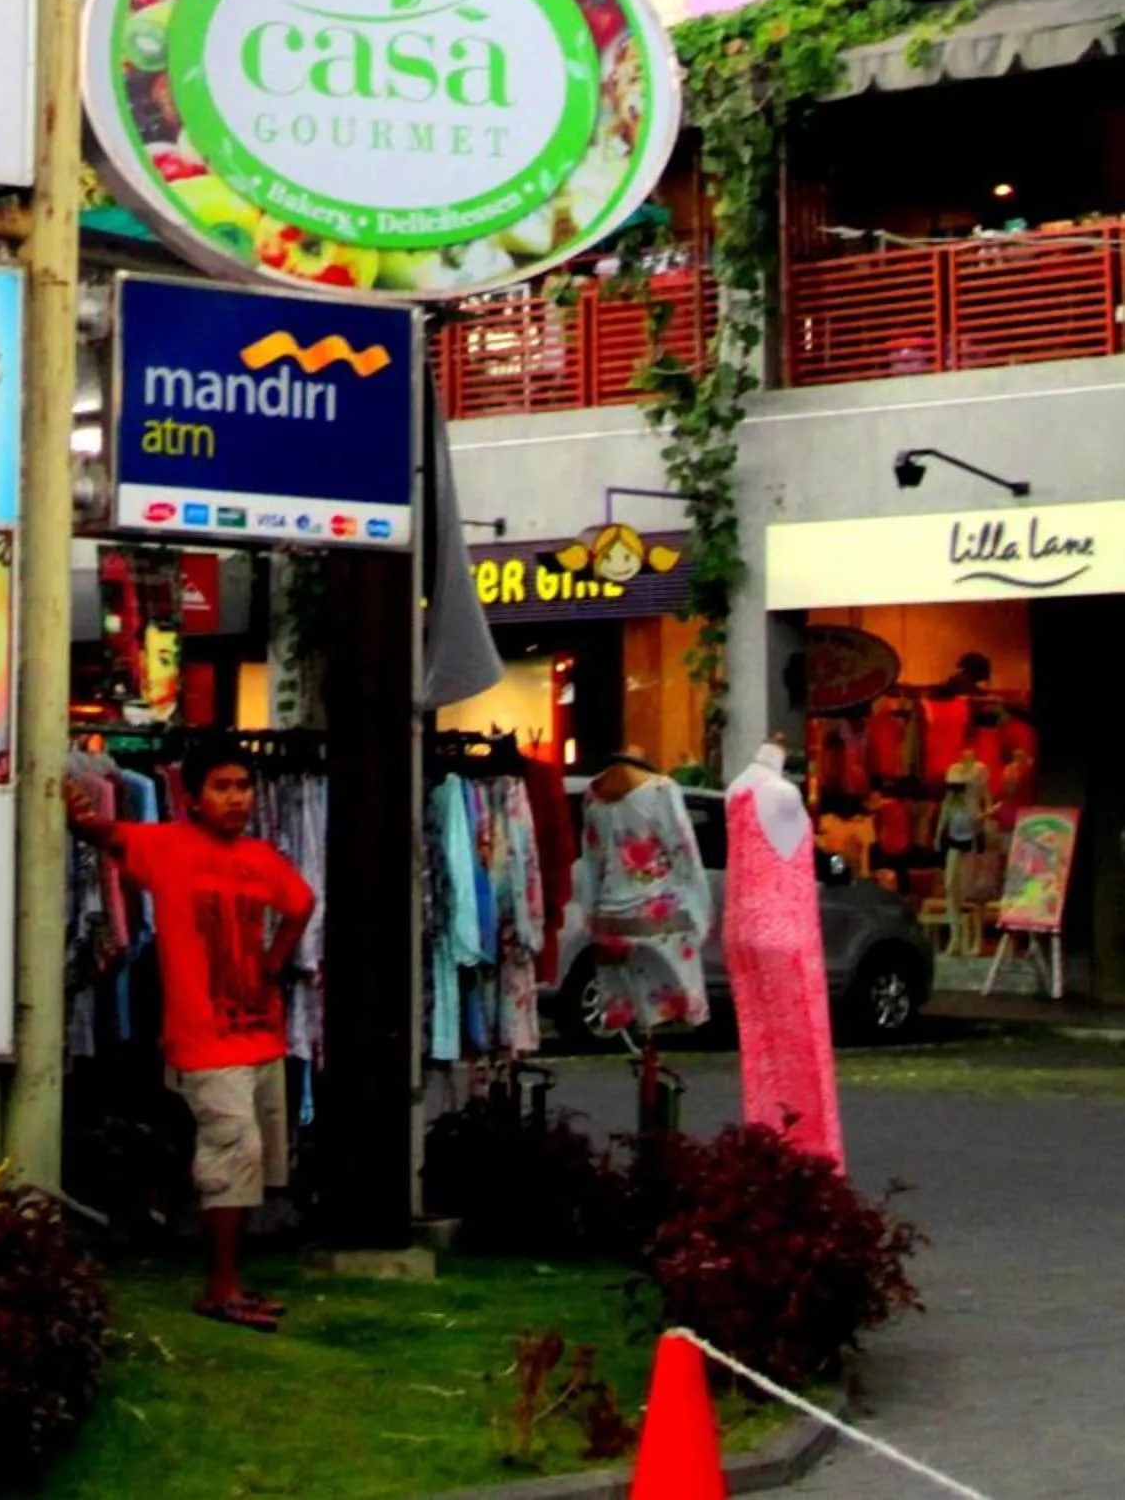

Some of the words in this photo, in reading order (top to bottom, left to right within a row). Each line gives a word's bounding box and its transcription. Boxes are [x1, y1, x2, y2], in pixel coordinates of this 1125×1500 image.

[253, 113, 511, 158] GOURMET
[267, 179, 354, 234] Bakery
[144, 364, 337, 422] mandiri
[141, 417, 215, 459] atm
